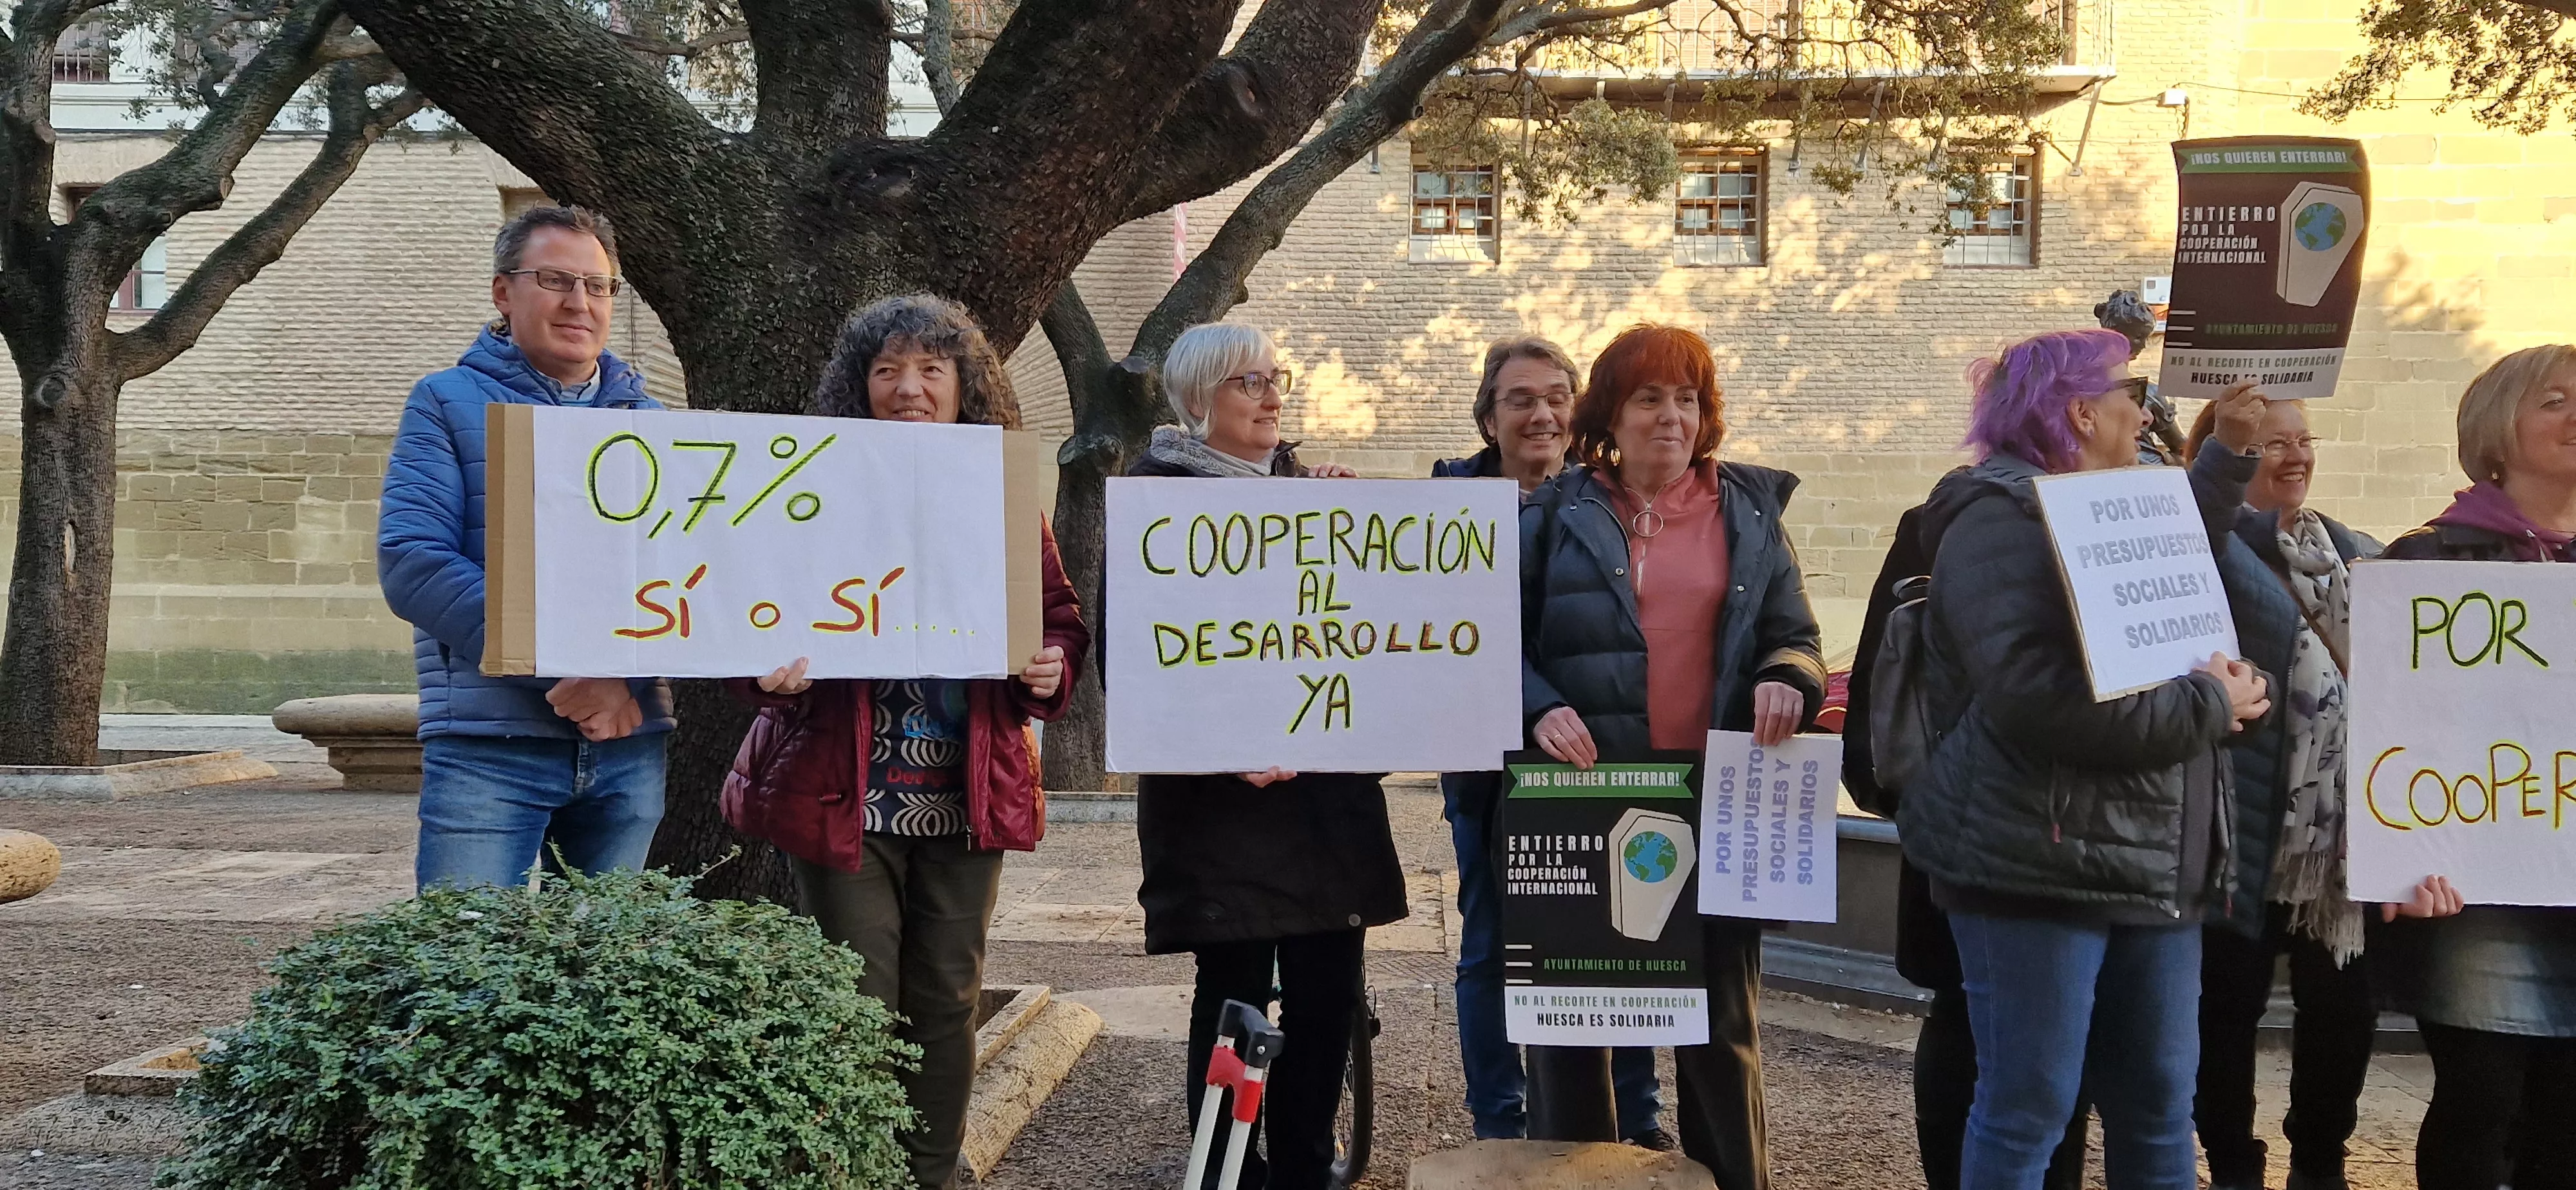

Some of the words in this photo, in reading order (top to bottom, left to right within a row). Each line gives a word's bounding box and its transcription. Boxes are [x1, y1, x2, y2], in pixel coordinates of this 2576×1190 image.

[2191, 152, 2220, 165] ¡NOS
[2224, 151, 2276, 164] QUIEREN
[2280, 151, 2347, 163] ENTERRAR!
[2182, 206, 2276, 222] ENTIERRO
[2181, 223, 2209, 236] POR
[2219, 223, 2235, 236] LA
[2179, 235, 2259, 250] COOPERACIÓN
[2177, 252, 2266, 263] INTERNACIONAL
[2171, 356, 2184, 366] NO
[2190, 357, 2202, 367] AL
[2208, 357, 2253, 368] RECORTE
[2259, 357, 2270, 368] EN
[2275, 354, 2336, 367] COOPERACIÓN
[2191, 372, 2238, 385] HUESCA
[2261, 371, 2314, 385] SOLIDARIA
[585, 432, 837, 540] 0,7%
[2089, 497, 2135, 524] POR
[2134, 494, 2181, 517] UNOS
[1141, 508, 1496, 577] COOPERACIÓN
[2076, 533, 2210, 569] PRESUPUESTOS
[1297, 571, 1351, 616] AL
[2113, 577, 2199, 607] SOCIALES
[2199, 572, 2210, 594] Y
[2125, 611, 2224, 648] SOLIDARIOS
[2412, 591, 2550, 669] POR
[1154, 619, 1481, 668] DESARROLLO
[1289, 673, 1351, 734] YA
[1775, 758, 1790, 773] Y
[1520, 771, 1549, 788] ¡NOS
[1553, 771, 1605, 788] QUIEREN
[1611, 771, 1680, 787] ENTERRAR!
[1717, 766, 1736, 825] UNOS
[1797, 760, 1818, 885] SOLIDARIOS
[1770, 780, 1789, 883] SOCIALES
[1508, 835, 1604, 851] ENTIERRO
[1508, 853, 1536, 866] POR
[1546, 853, 1562, 866] LA
[1716, 831, 1732, 874] POR
[1508, 865, 1587, 880] COOPERACIÓN
[1508, 882, 1598, 895] INTERNACIONAL
[1544, 958, 1624, 971] AYUNTAMIENTO
[1629, 959, 1641, 971] DE
[1646, 959, 1687, 972] HUESCA
[1515, 995, 1528, 1006] NO
[1533, 995, 1546, 1006] AL
[1551, 996, 1597, 1008] RECORTE
[1603, 996, 1616, 1008] EN
[1621, 994, 1697, 1008] COOPERACIÓN
[1537, 1013, 1584, 1026] HUESCA
[1589, 1014, 1604, 1027] ES
[1609, 1014, 1674, 1028] SOLIDARIA
